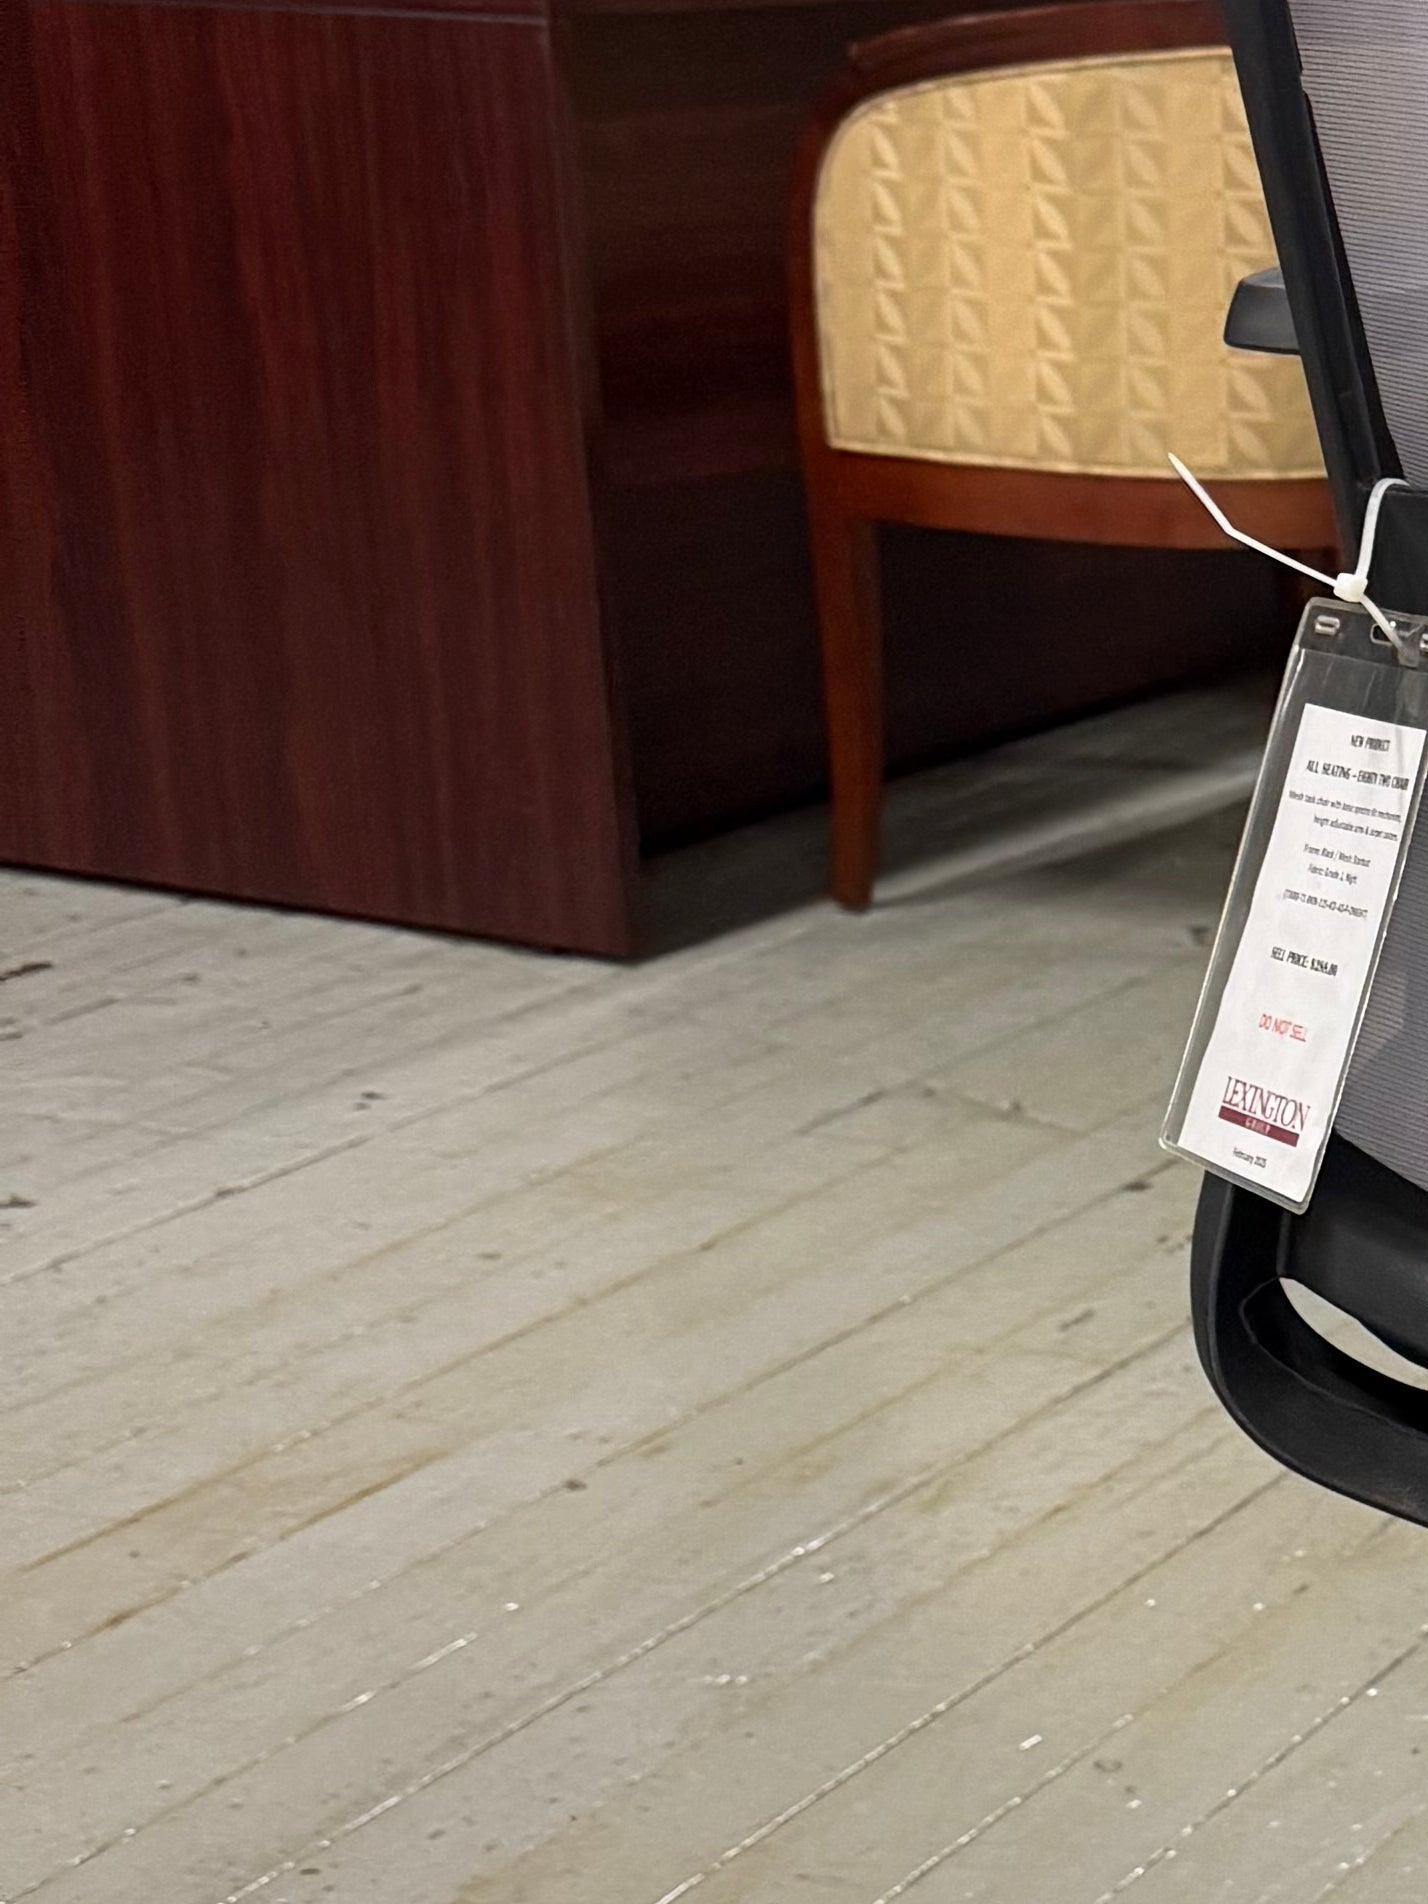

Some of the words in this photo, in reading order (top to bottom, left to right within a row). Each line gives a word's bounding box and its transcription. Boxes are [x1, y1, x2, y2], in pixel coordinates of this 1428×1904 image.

[1306, 760, 1319, 774] ALL
[1322, 763, 1351, 779] SEATING
[1259, 1013, 1272, 1030] DO
[1272, 1018, 1292, 1035] NOT
[1222, 1076, 1310, 1130] LEXINGTON
